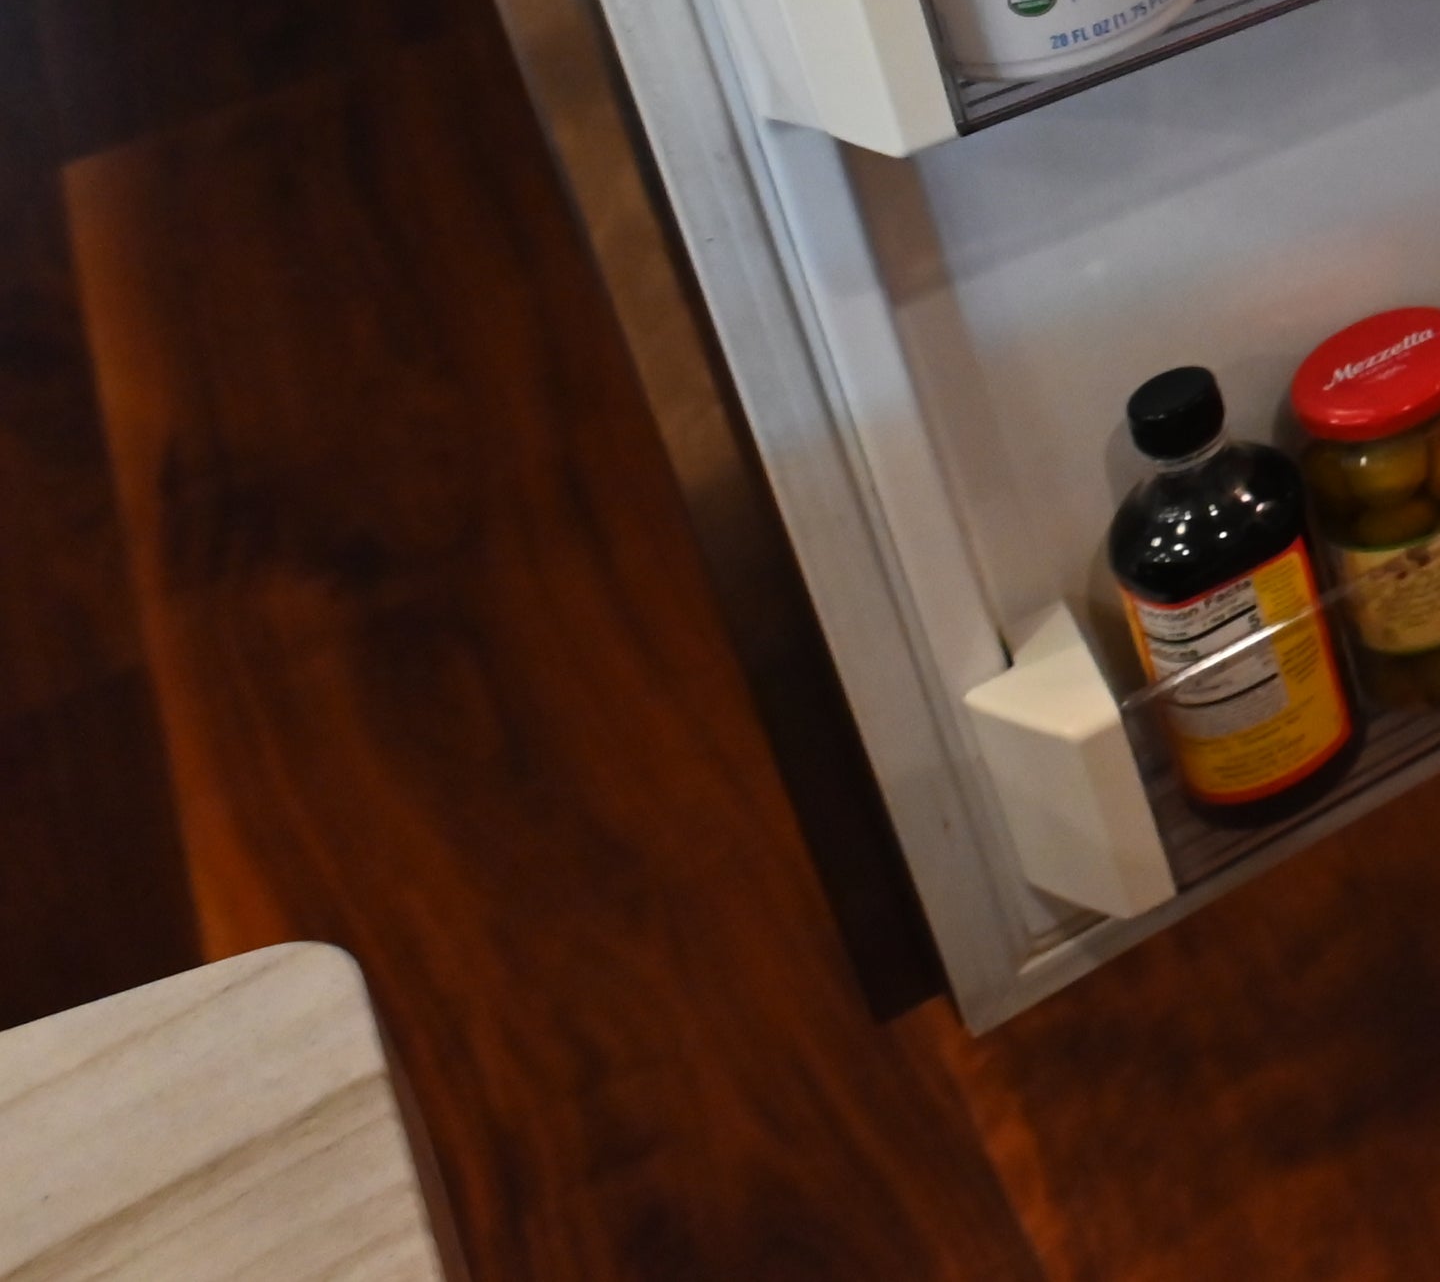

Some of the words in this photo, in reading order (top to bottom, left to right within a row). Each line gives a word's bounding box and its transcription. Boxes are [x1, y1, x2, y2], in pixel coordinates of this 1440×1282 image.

[1072, 27, 1089, 44] FL
[1093, 20, 1111, 37] OZ
[1323, 329, 1434, 391] Mezzetta
